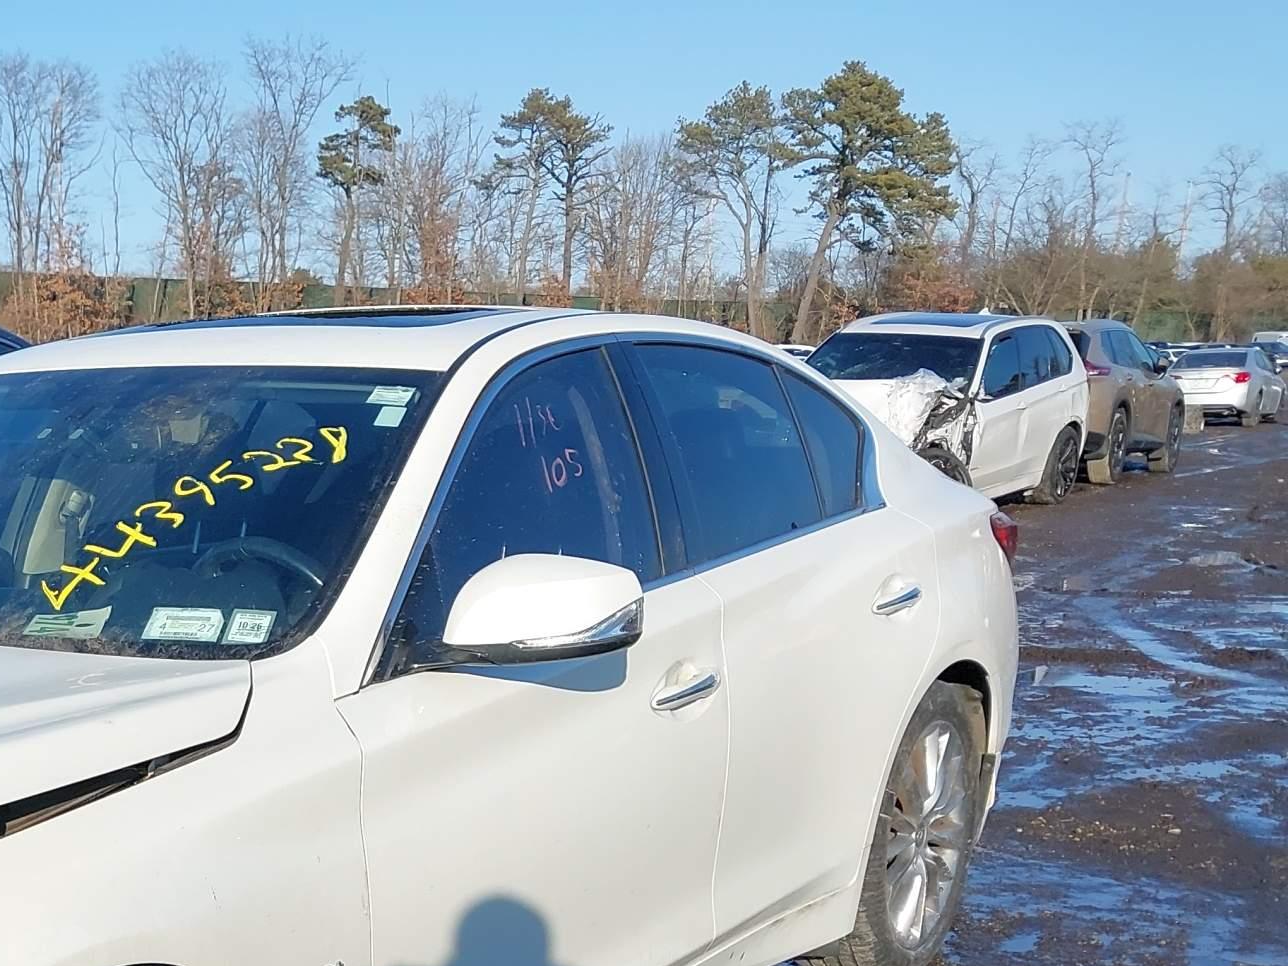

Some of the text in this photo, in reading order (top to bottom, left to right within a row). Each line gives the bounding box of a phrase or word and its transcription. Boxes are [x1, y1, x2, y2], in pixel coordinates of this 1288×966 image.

[540, 448, 583, 494] 105
[41, 426, 348, 611] 44395228
[197, 623, 216, 633] 27
